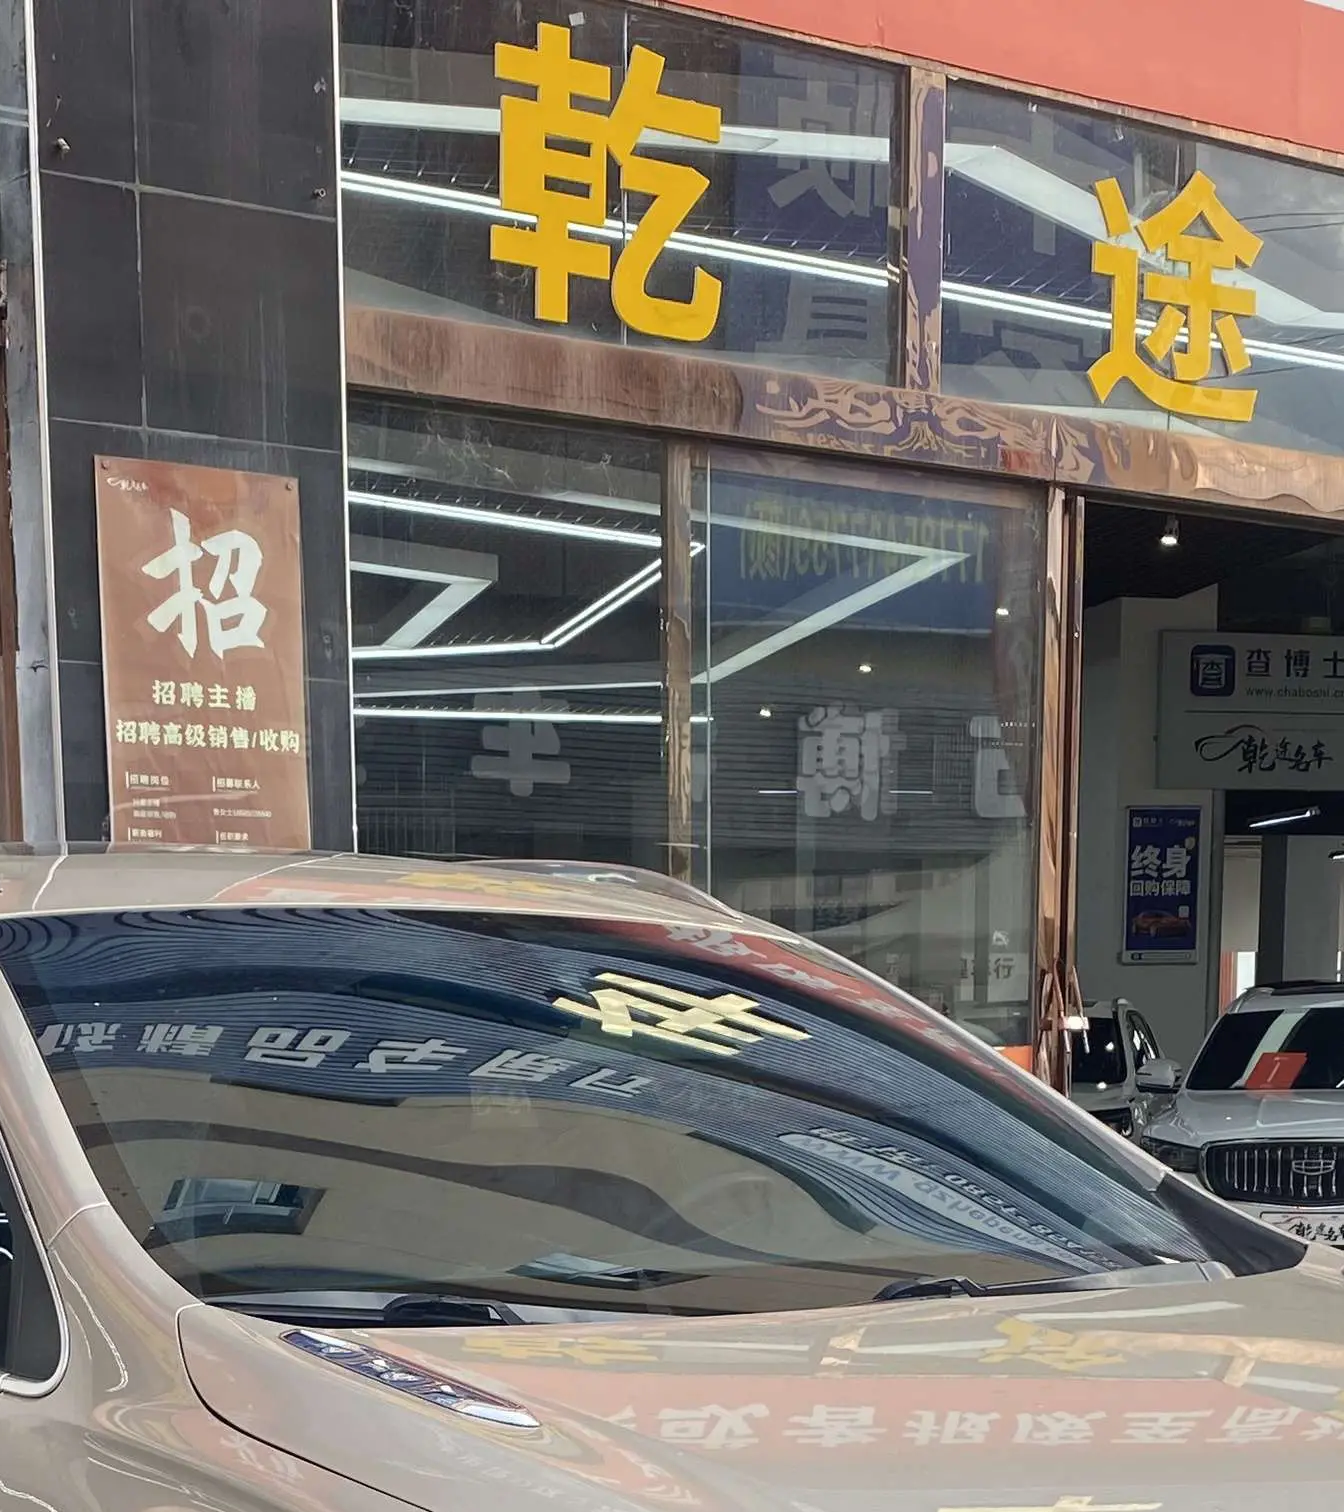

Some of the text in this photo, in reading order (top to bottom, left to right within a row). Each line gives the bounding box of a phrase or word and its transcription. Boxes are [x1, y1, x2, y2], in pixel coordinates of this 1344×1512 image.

[142, 507, 268, 660] 招
[152, 679, 257, 711] 招聘主播
[116, 719, 300, 754] 招聘高级销售/收购
[1130, 844, 1192, 879] 终身
